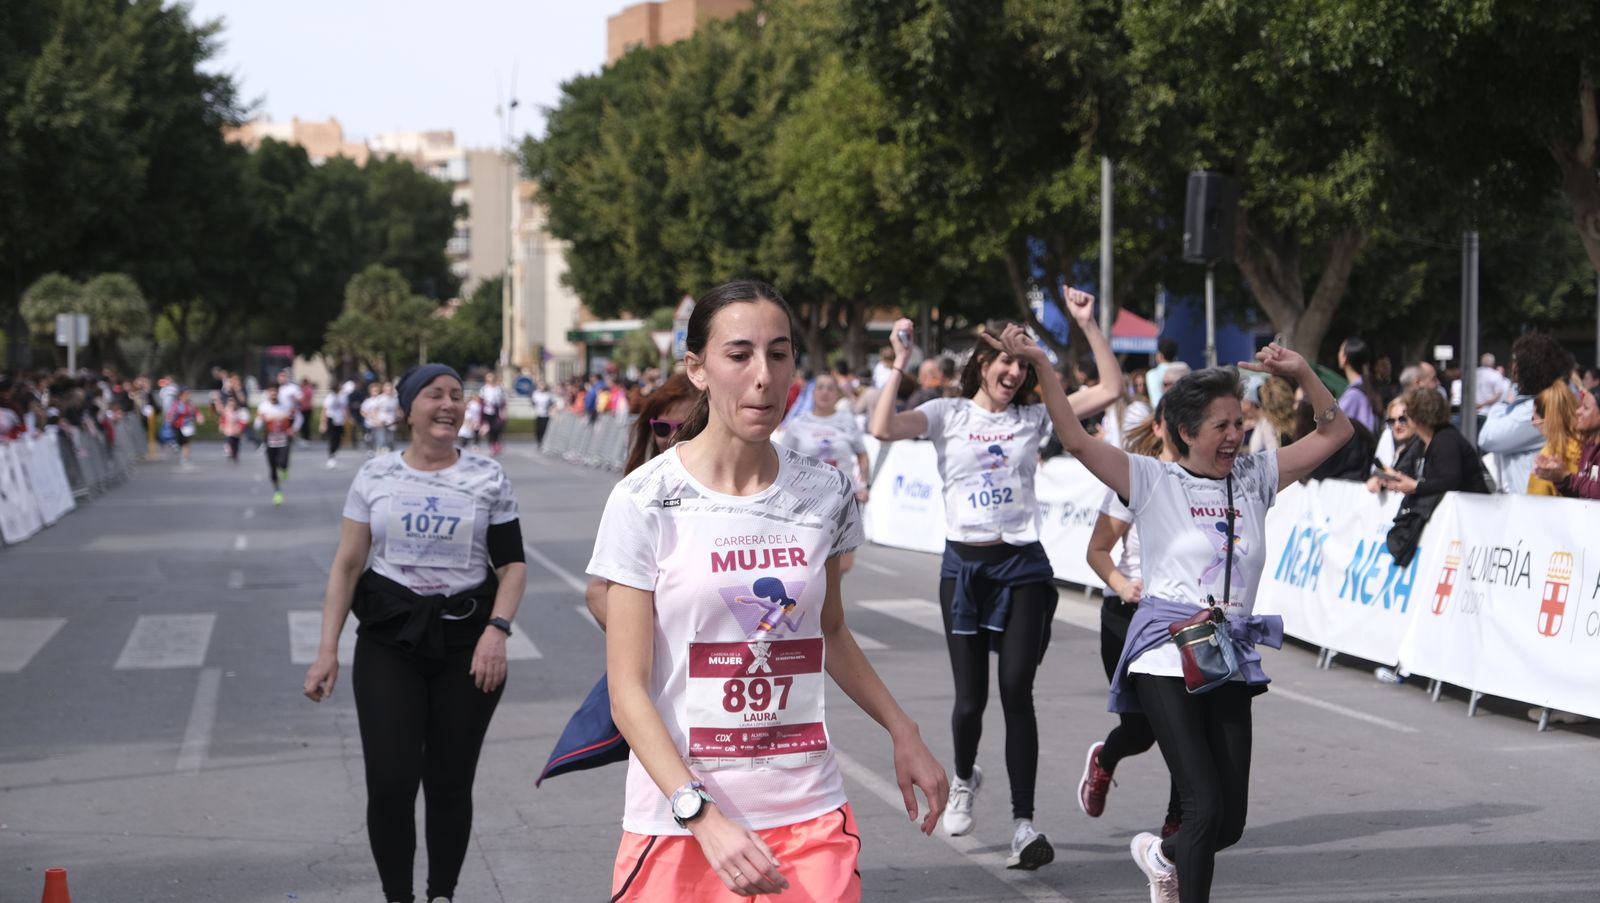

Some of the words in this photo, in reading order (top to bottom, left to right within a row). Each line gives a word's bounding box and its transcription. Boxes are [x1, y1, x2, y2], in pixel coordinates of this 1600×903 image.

[968, 433, 1015, 442] MUJER
[968, 487, 1014, 508] 1052
[401, 512, 461, 535] 1077
[714, 535, 766, 547] CARRERA
[767, 535, 782, 544] DE
[784, 534, 798, 543] LA
[710, 547, 808, 573] MUJER
[1338, 539, 1422, 613] NEXA
[708, 656, 743, 665] MUJER
[722, 676, 793, 713] 897
[743, 712, 778, 723] LAURA
[715, 733, 733, 742] CDX
